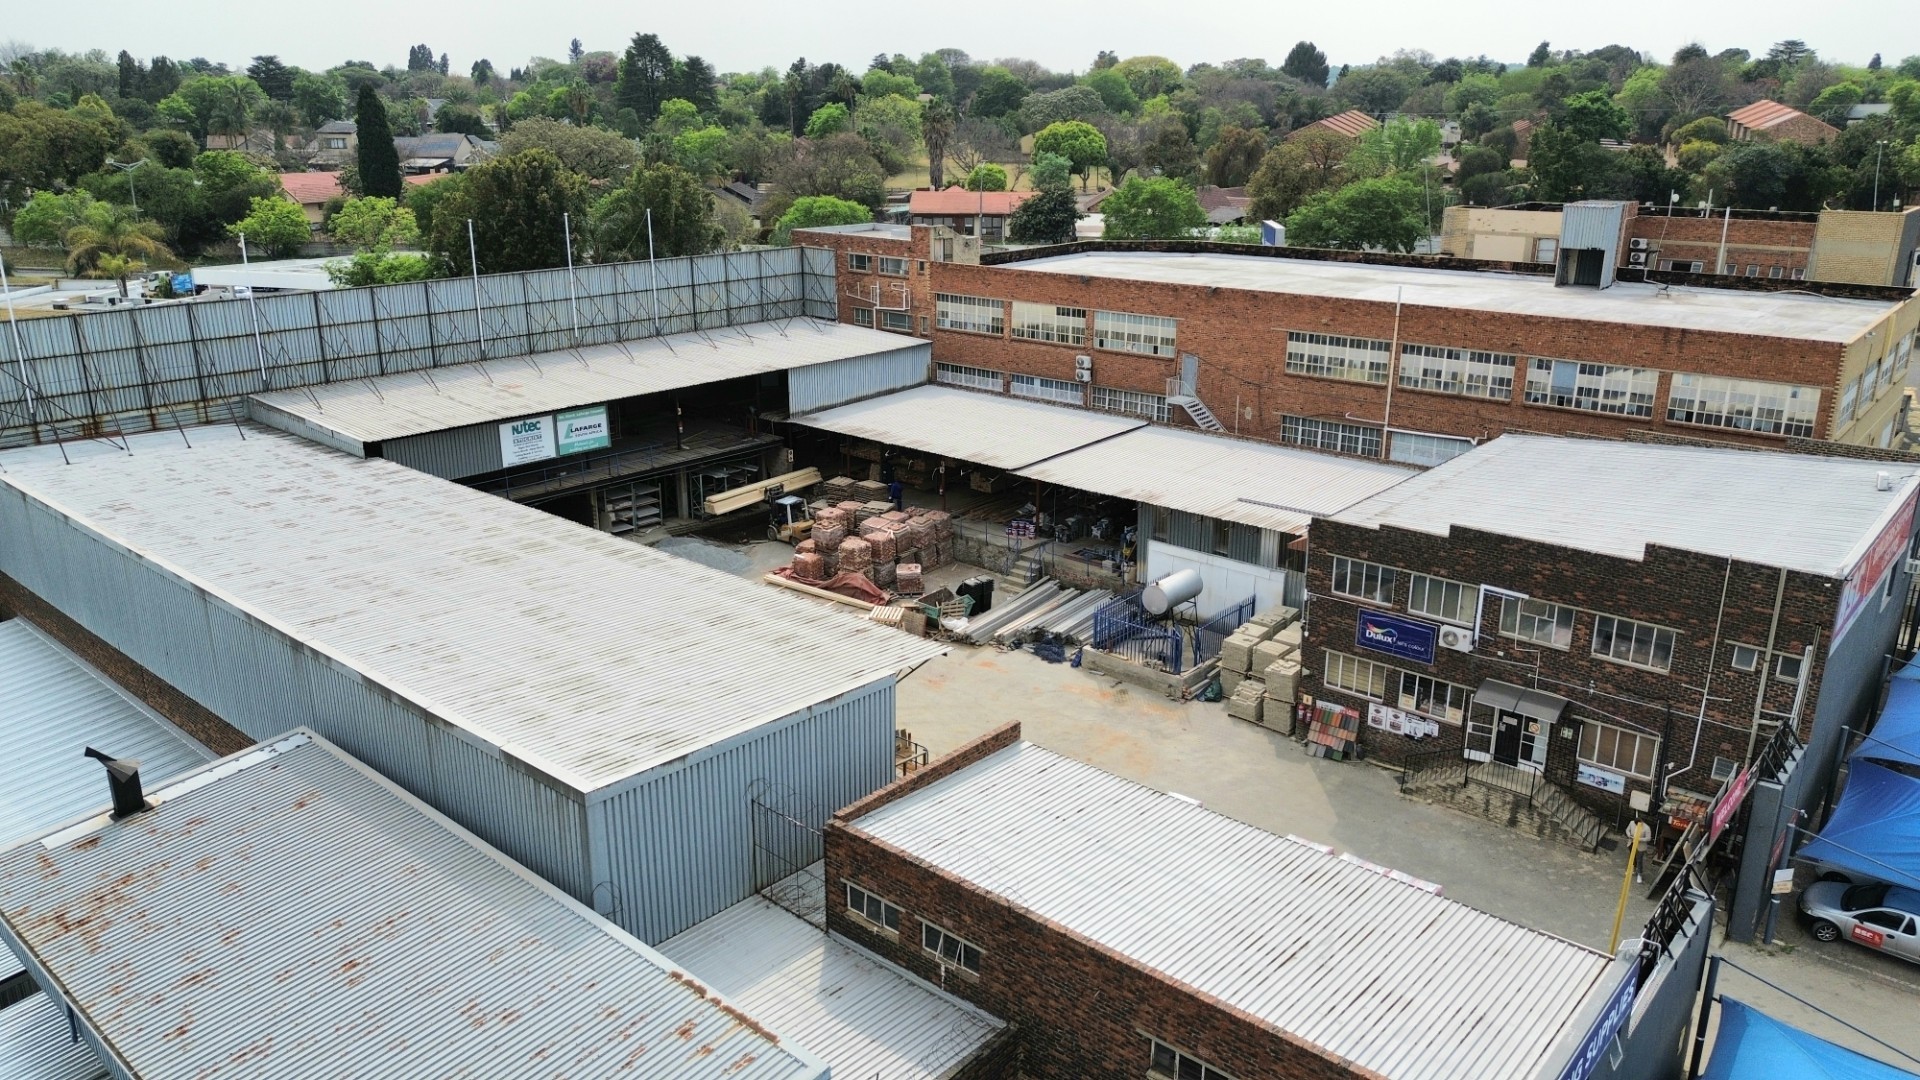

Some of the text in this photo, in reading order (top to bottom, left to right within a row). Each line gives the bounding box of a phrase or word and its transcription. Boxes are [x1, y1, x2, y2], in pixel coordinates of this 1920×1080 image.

[570, 422, 602, 433] LAFARGE
[1366, 629, 1393, 644] Dulux
[1585, 977, 1636, 1069] SUPPLIES
